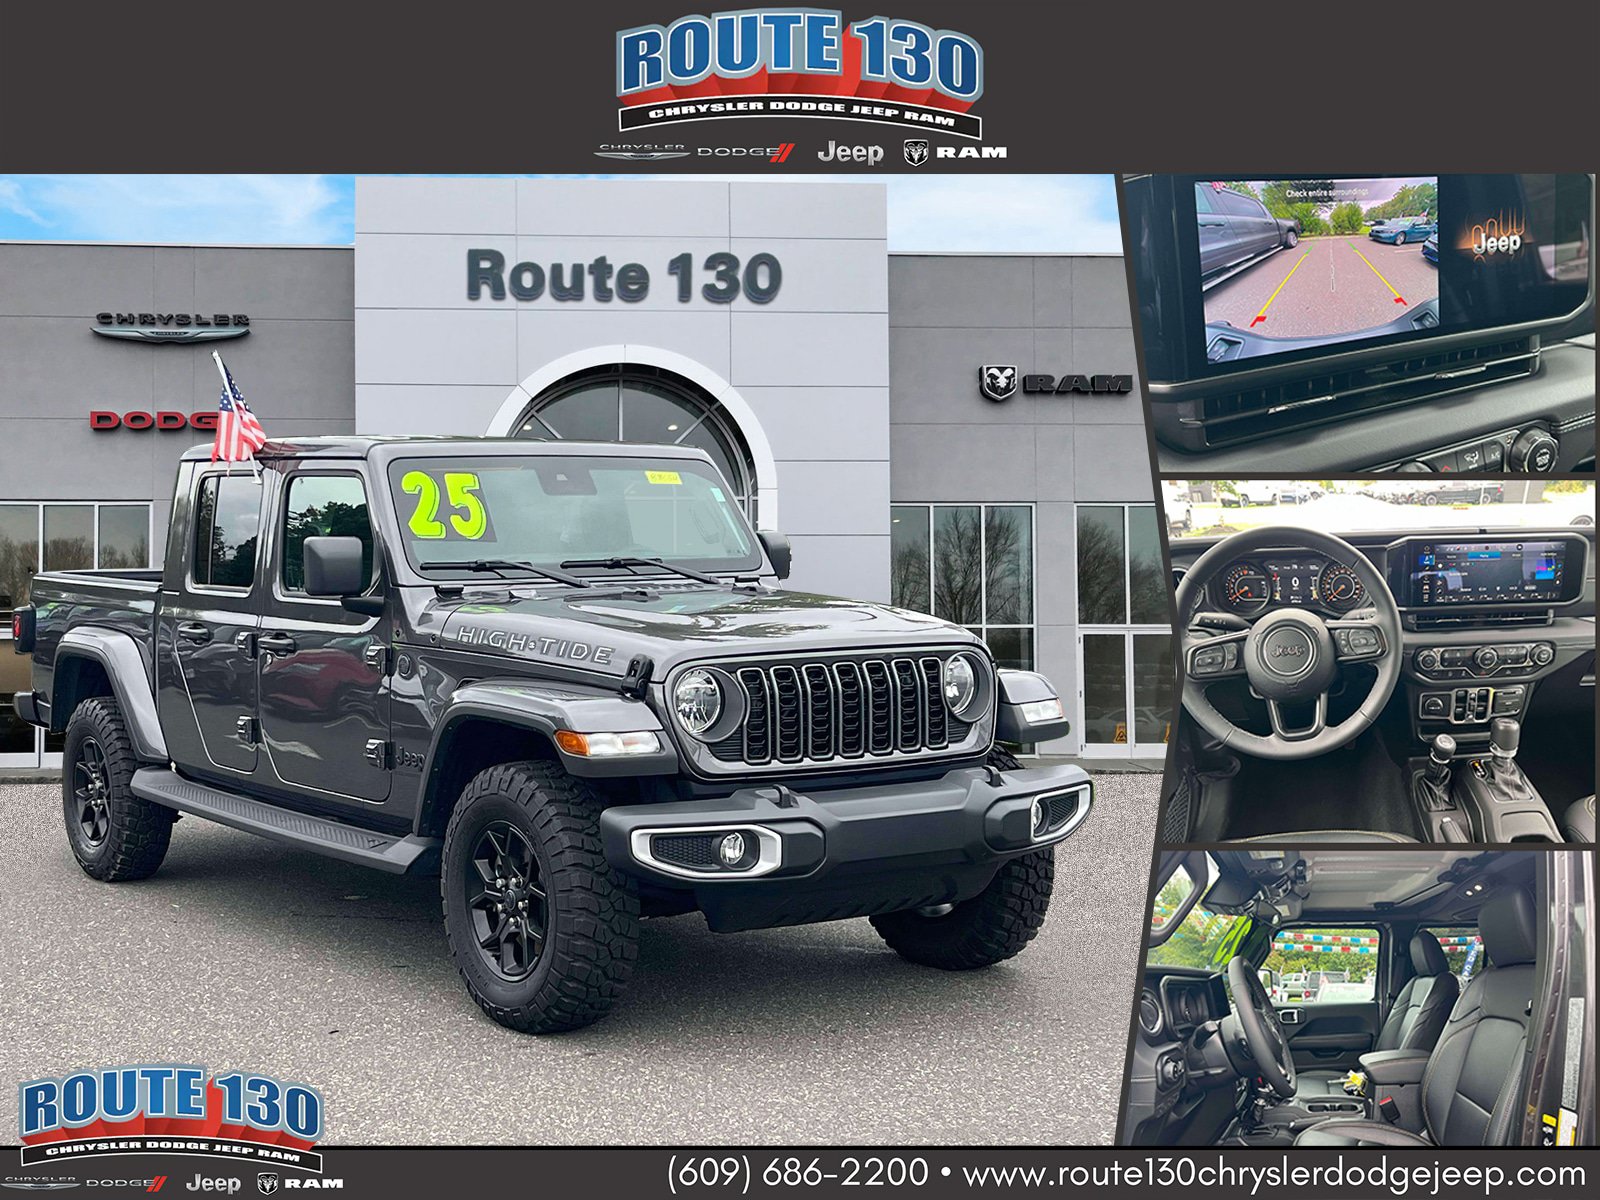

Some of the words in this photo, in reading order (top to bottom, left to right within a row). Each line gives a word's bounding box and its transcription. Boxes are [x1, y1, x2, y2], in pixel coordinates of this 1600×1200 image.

[1286, 189, 1309, 198] Check
[1308, 188, 1328, 197] entire
[1473, 233, 1521, 255] Jeep
[467, 248, 650, 302] Route
[668, 252, 782, 304] 130
[96, 312, 250, 326] CHRYSLER
[1022, 374, 1133, 394] RAM
[90, 410, 220, 430] DODG
[401, 471, 487, 540] 25
[395, 746, 426, 772] Jeep
